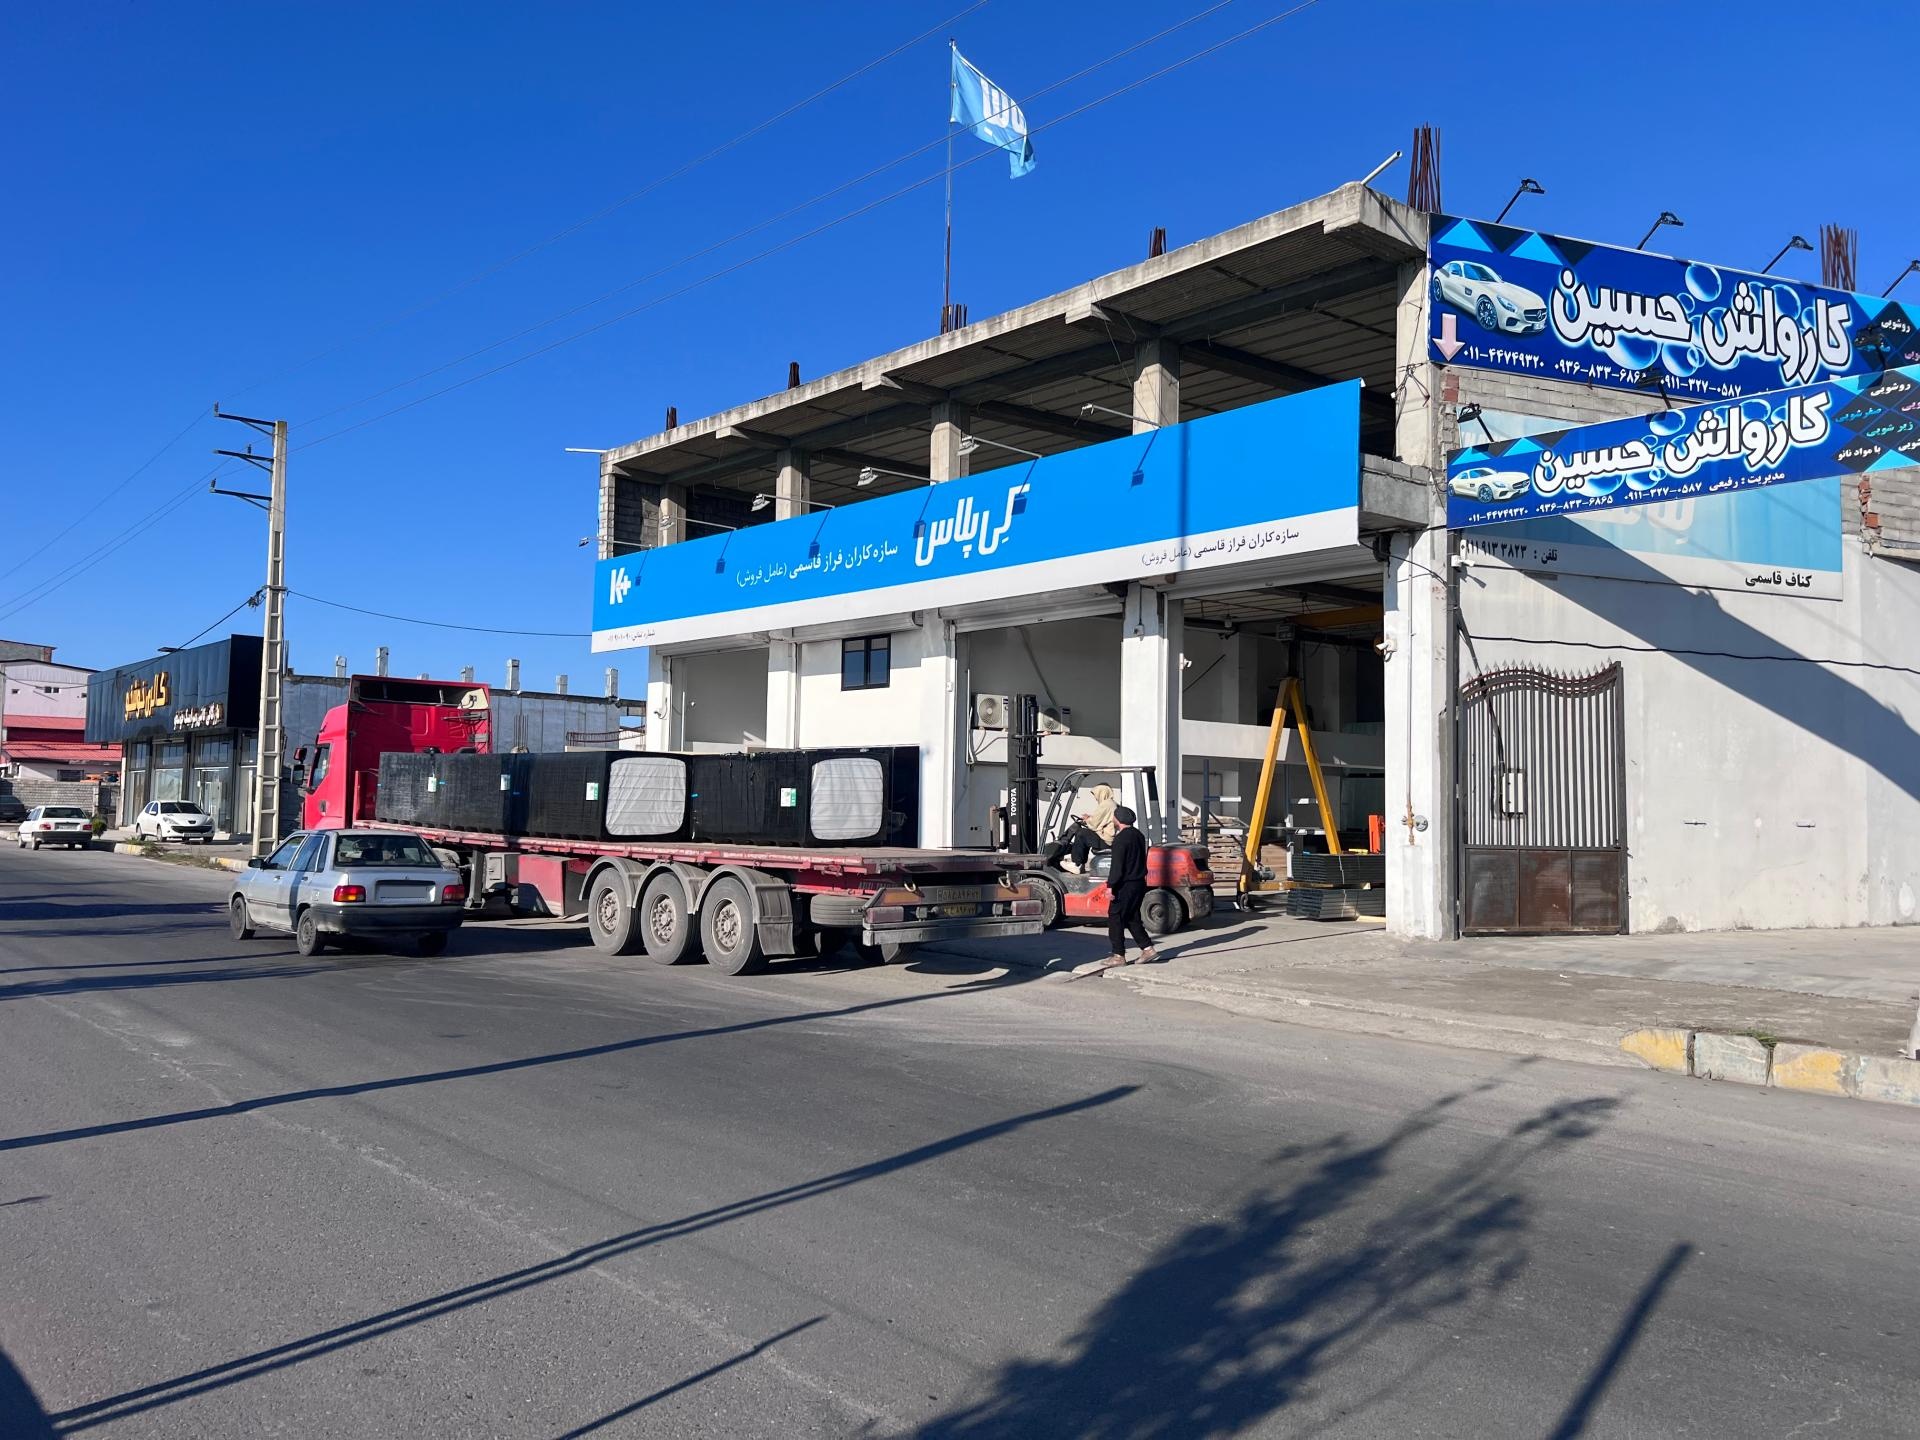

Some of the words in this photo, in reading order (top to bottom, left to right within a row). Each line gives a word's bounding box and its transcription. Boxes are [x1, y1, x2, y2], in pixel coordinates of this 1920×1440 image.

[1551, 268, 1692, 347] حسین
[1701, 280, 1852, 384] کارواش
[1881, 319, 1911, 333] روشویی
[1664, 389, 1830, 474] کارواش
[1534, 440, 1654, 493] حسین
[1709, 479, 1739, 492] رفیعی
[1748, 472, 1785, 485] مدیریت
[915, 496, 980, 567] پلاس
[1194, 539, 1225, 558] قاسمی
[1228, 535, 1246, 553] فراز
[823, 549, 843, 572] فراز
[1541, 548, 1558, 564] تلفن
[789, 553, 822, 579] قاسمی
[1745, 570, 1782, 587] قاسمی
[1785, 572, 1812, 588] کناف
